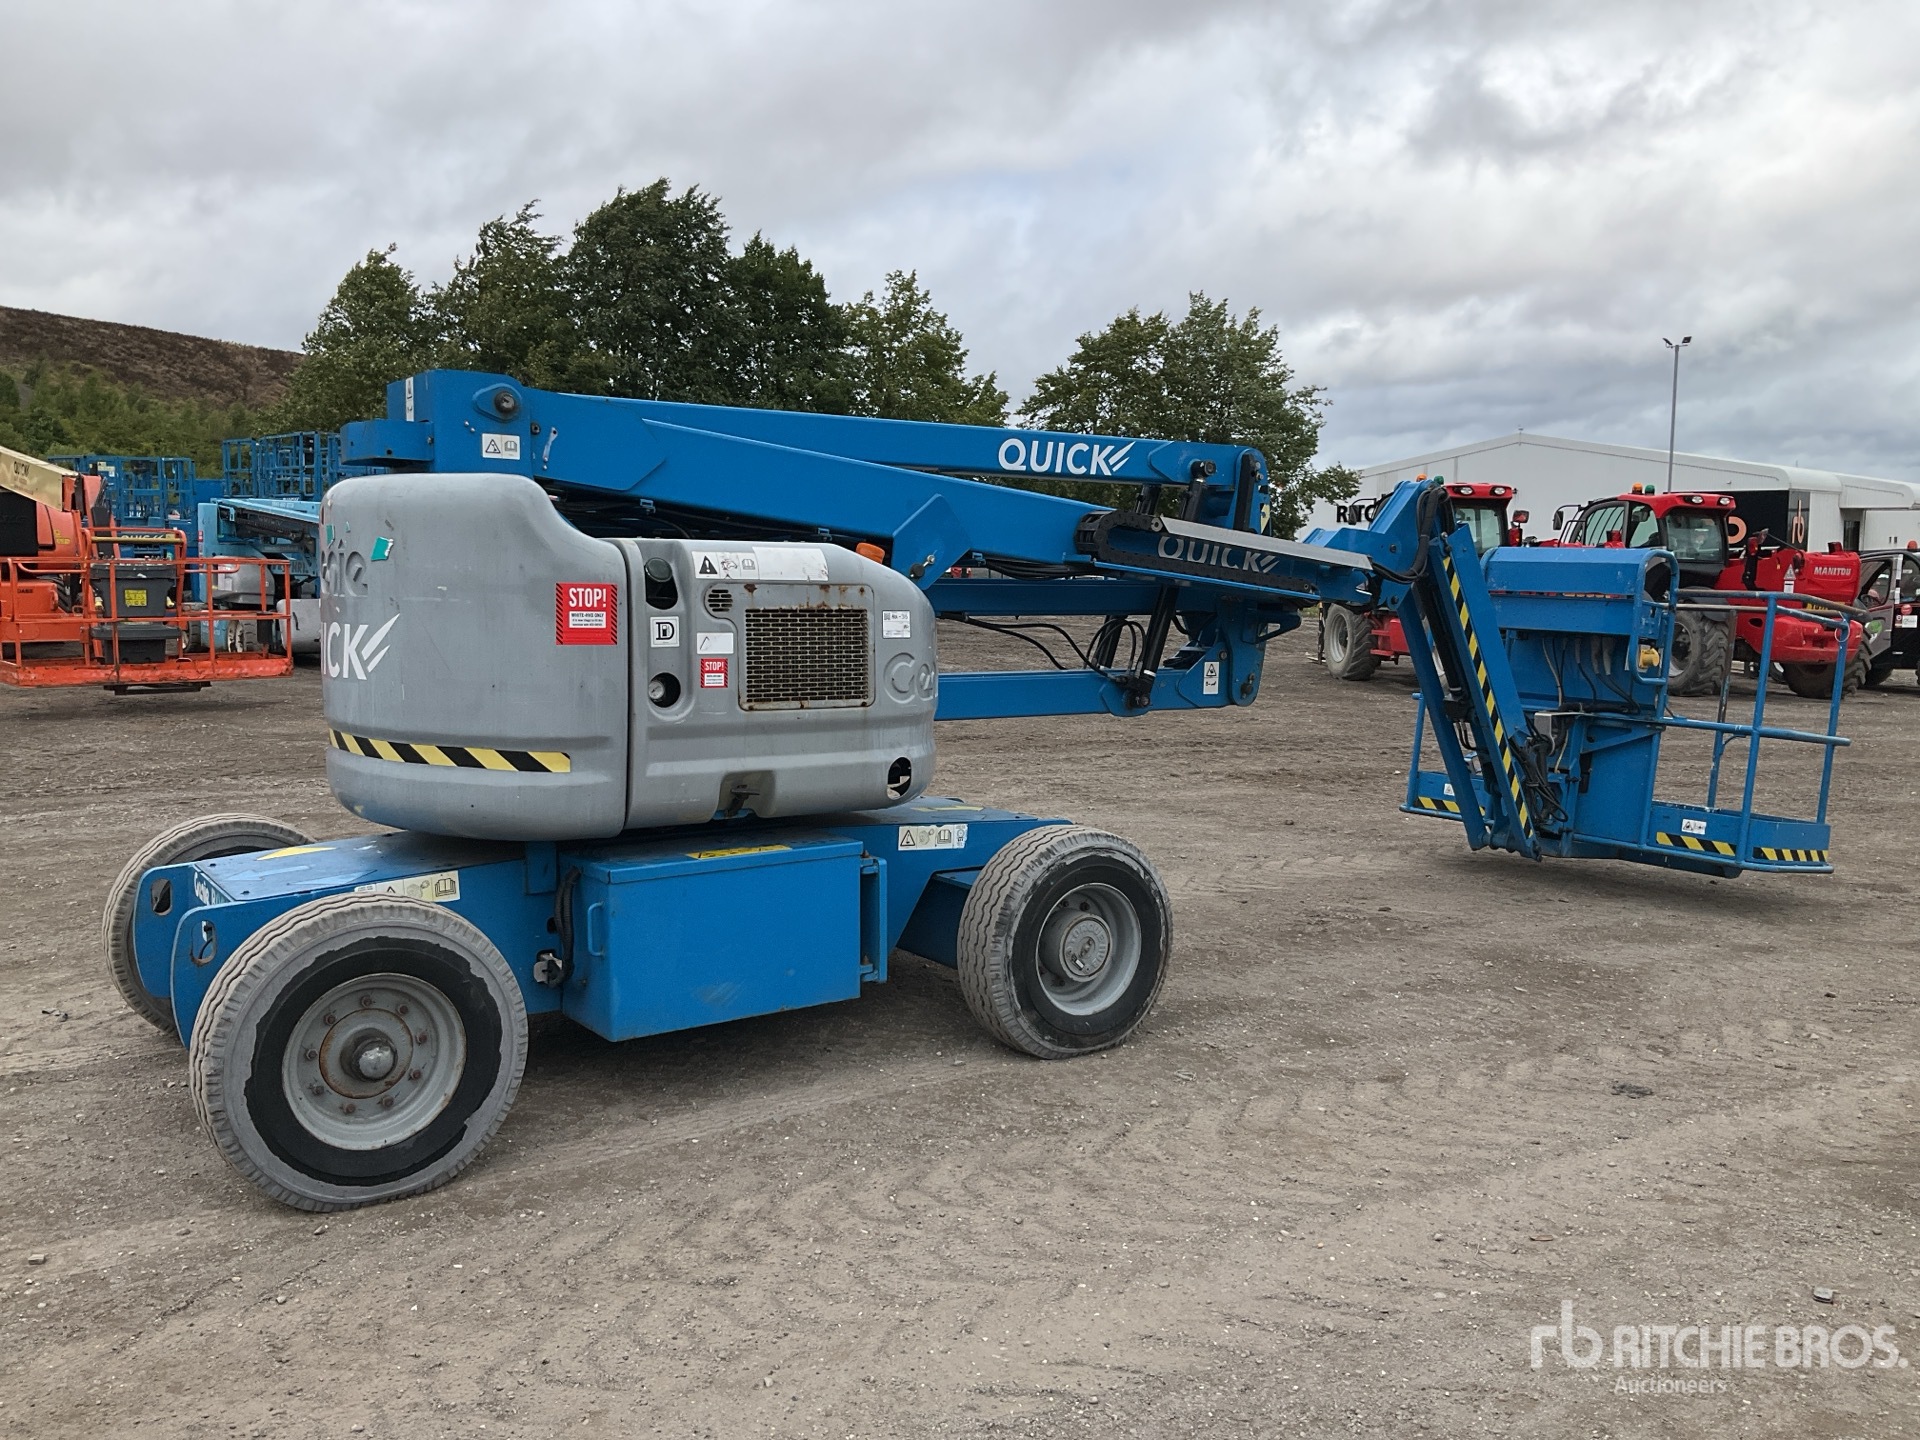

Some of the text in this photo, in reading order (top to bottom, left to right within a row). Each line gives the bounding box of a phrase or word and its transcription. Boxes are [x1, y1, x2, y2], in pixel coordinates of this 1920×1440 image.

[998, 438, 1115, 476] QUICK
[1157, 535, 1261, 573] QUICK
[1813, 566, 1852, 576] MANITOU
[568, 587, 607, 608] STOP!
[321, 621, 367, 681] ICK
[705, 661, 725, 671] STOP!
